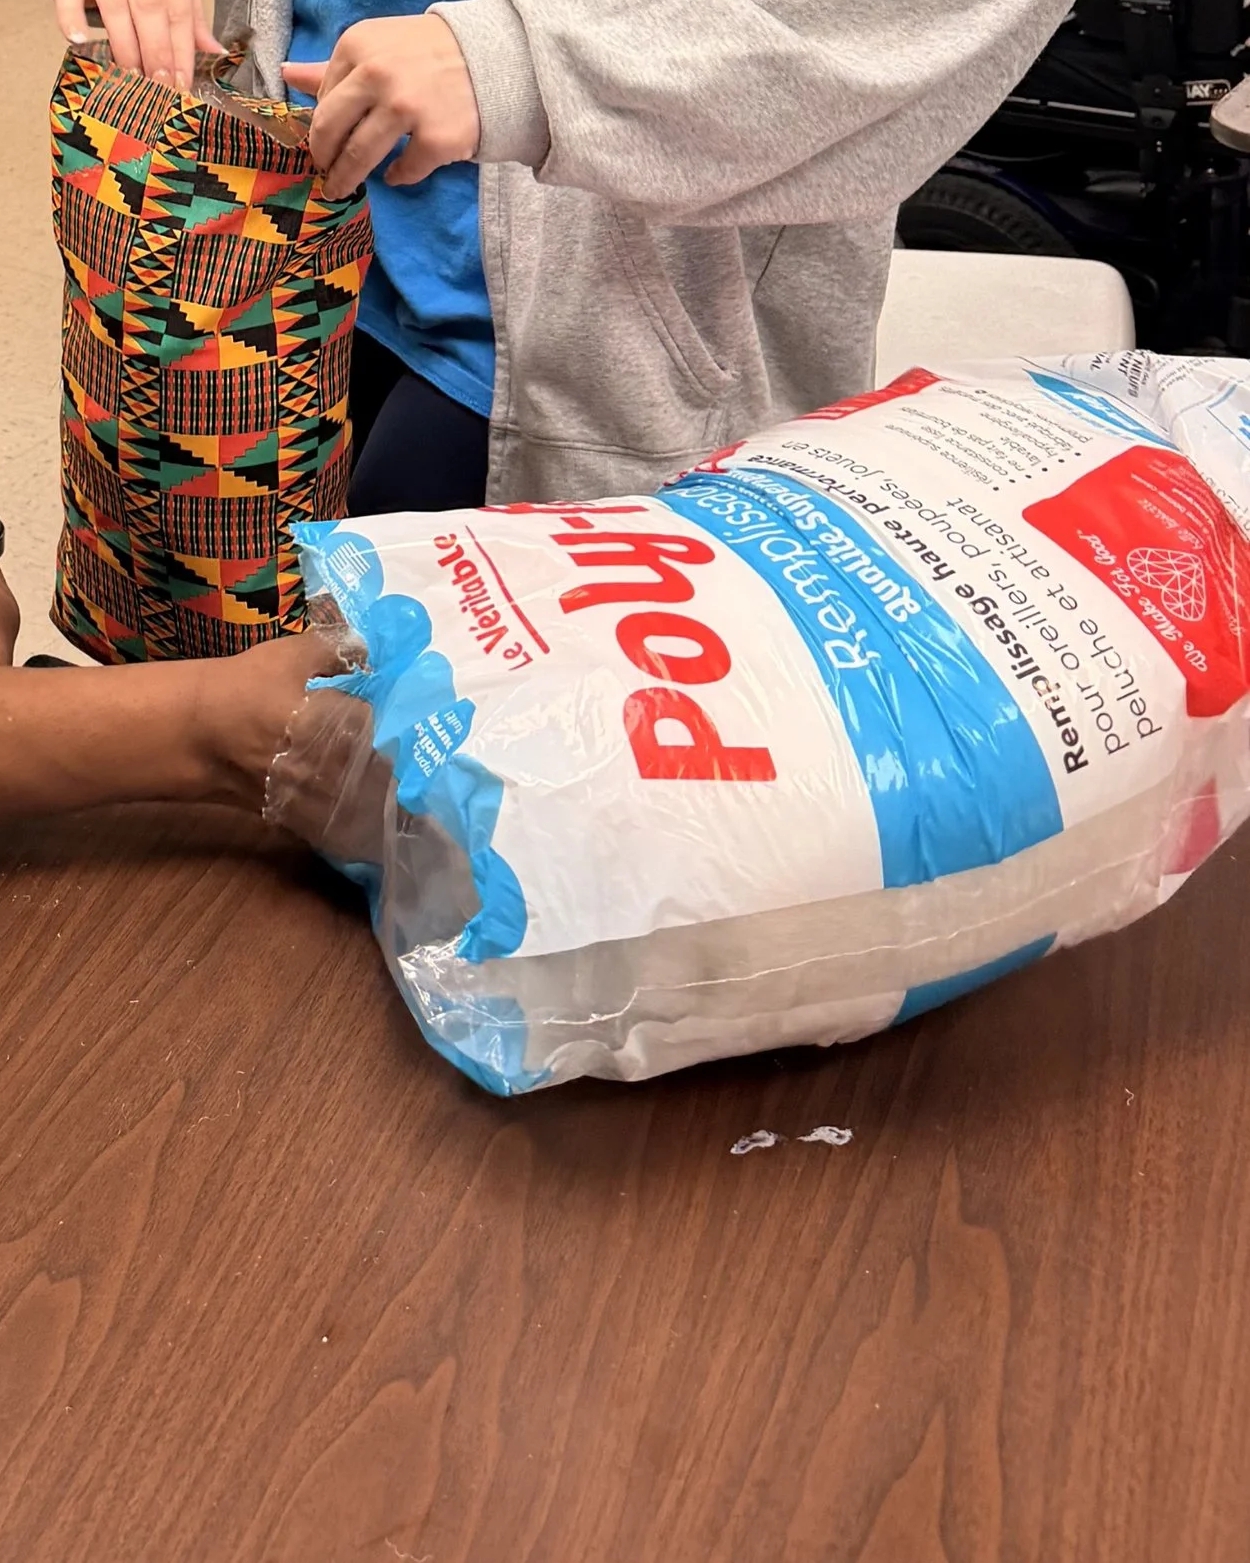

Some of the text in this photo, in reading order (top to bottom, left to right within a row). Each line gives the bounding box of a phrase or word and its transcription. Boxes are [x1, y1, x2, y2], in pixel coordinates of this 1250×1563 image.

[781, 440, 804, 452] en
[807, 446, 885, 481] jouets
[749, 454, 890, 515] performance
[880, 477, 992, 559] poupées,
[809, 527, 922, 623] Qualité
[884, 518, 957, 582] haute
[1084, 533, 1116, 566] Good
[433, 532, 534, 672] Le Véritable
[944, 496, 1164, 741] peluche et artisanat
[987, 562, 1081, 672] oreillers,
[1139, 596, 1184, 642] Make
[954, 582, 1090, 775] Remplissage
[1183, 640, 1208, 672] We
[1075, 681, 1131, 755] pour
